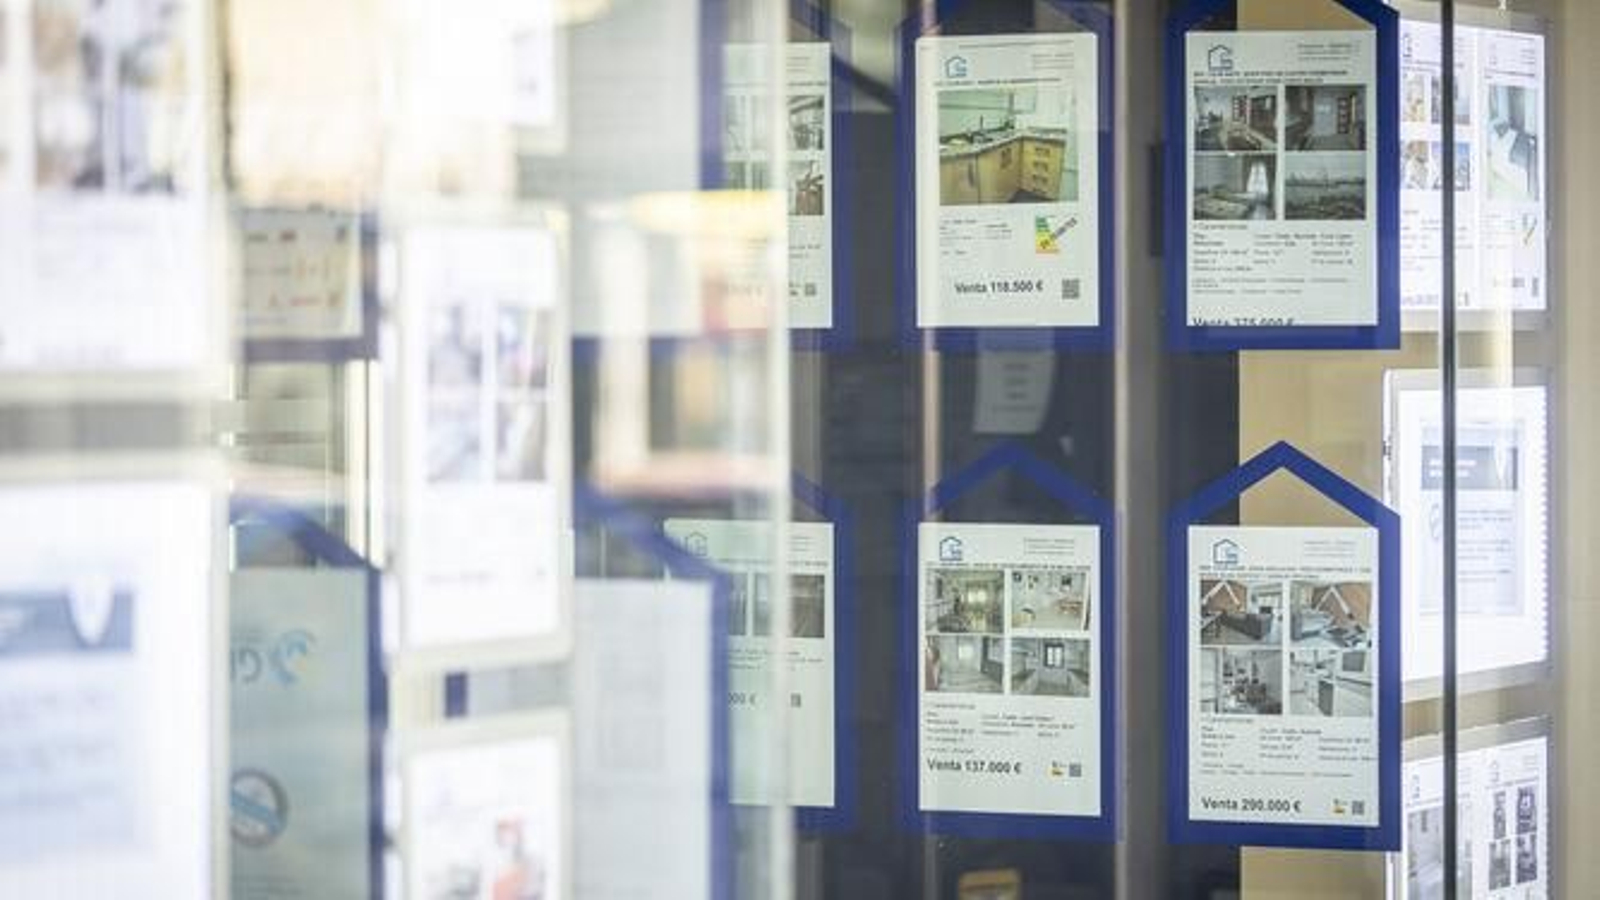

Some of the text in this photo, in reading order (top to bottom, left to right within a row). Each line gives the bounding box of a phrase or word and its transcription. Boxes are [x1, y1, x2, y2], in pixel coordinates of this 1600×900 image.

[954, 282, 987, 294] Venta
[1036, 280, 1044, 292] €
[927, 759, 1022, 775] Venta 137.000 €
[1201, 798, 1302, 813] Venta 290.000 €
